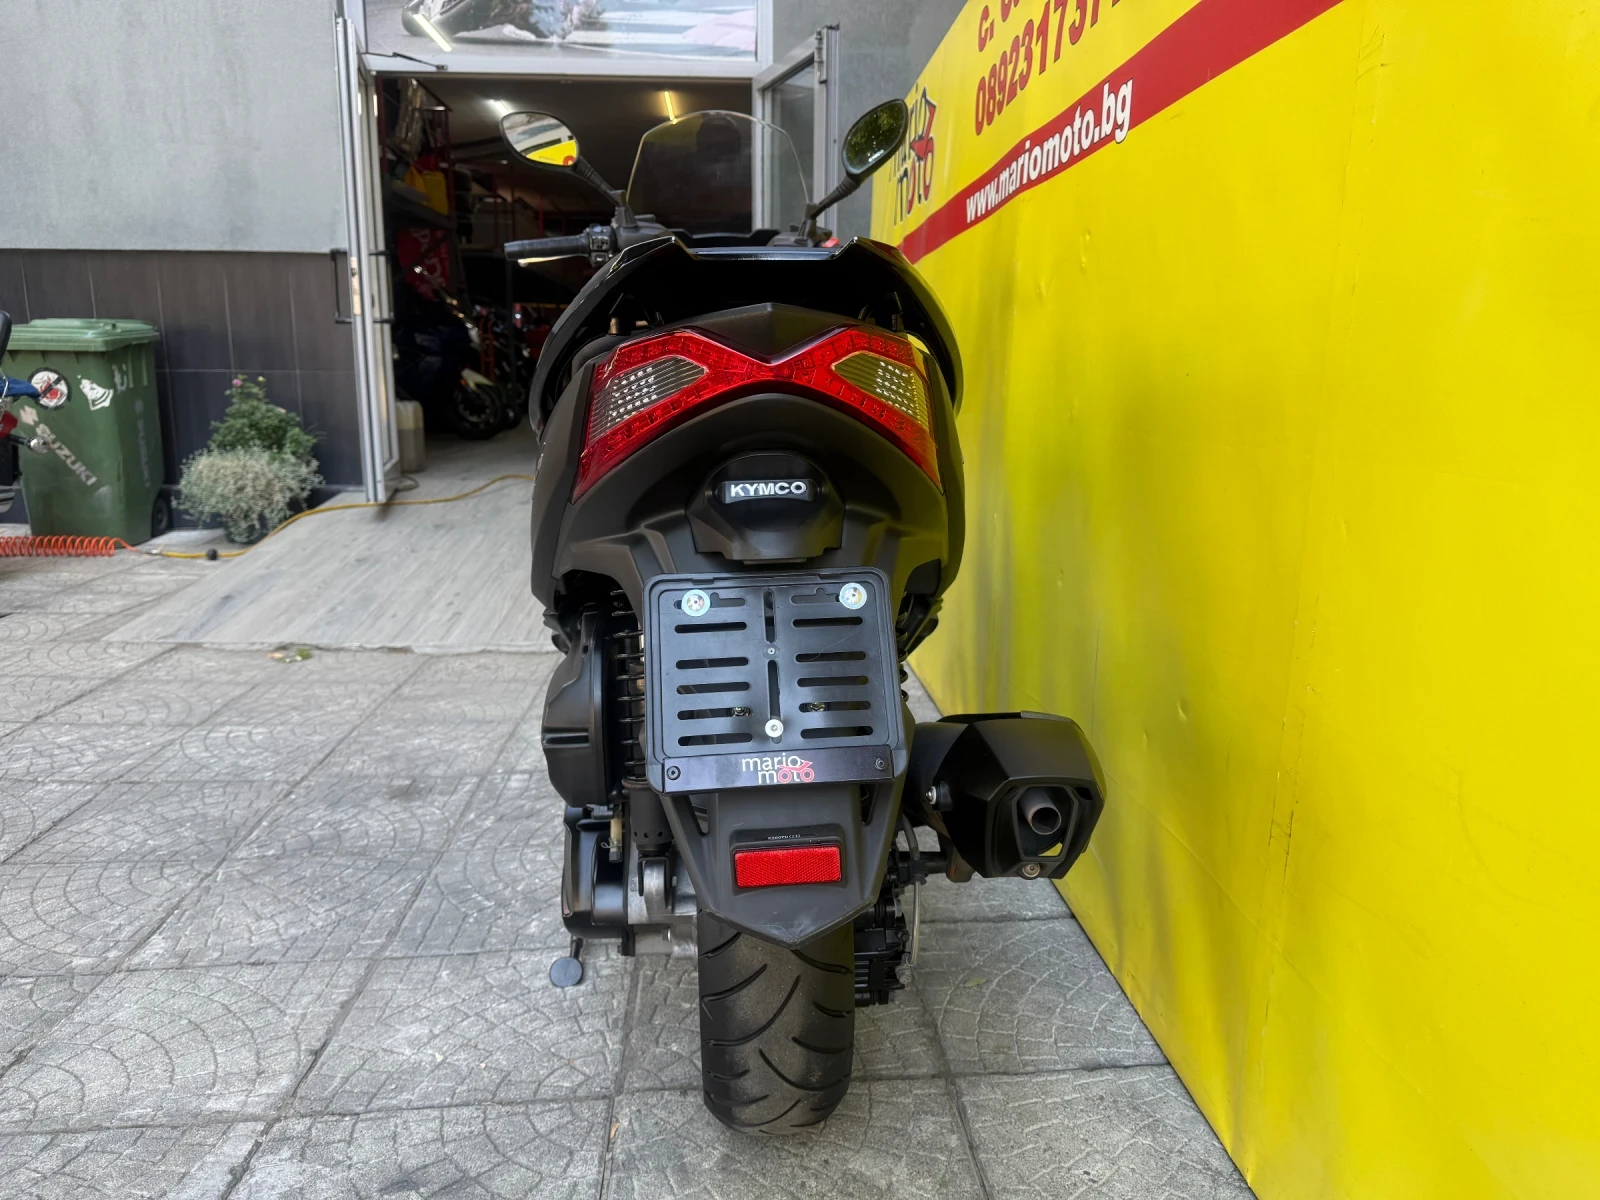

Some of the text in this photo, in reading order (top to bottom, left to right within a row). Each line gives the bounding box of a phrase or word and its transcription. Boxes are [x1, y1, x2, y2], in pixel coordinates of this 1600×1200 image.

[975, 0, 1120, 136] 08923173
[966, 77, 1133, 224] www.mariomoto.bg
[35, 423, 98, 487] SUZUKI
[730, 481, 807, 498] KYMCO
[741, 752, 801, 772] mario
[758, 768, 815, 784] moto
